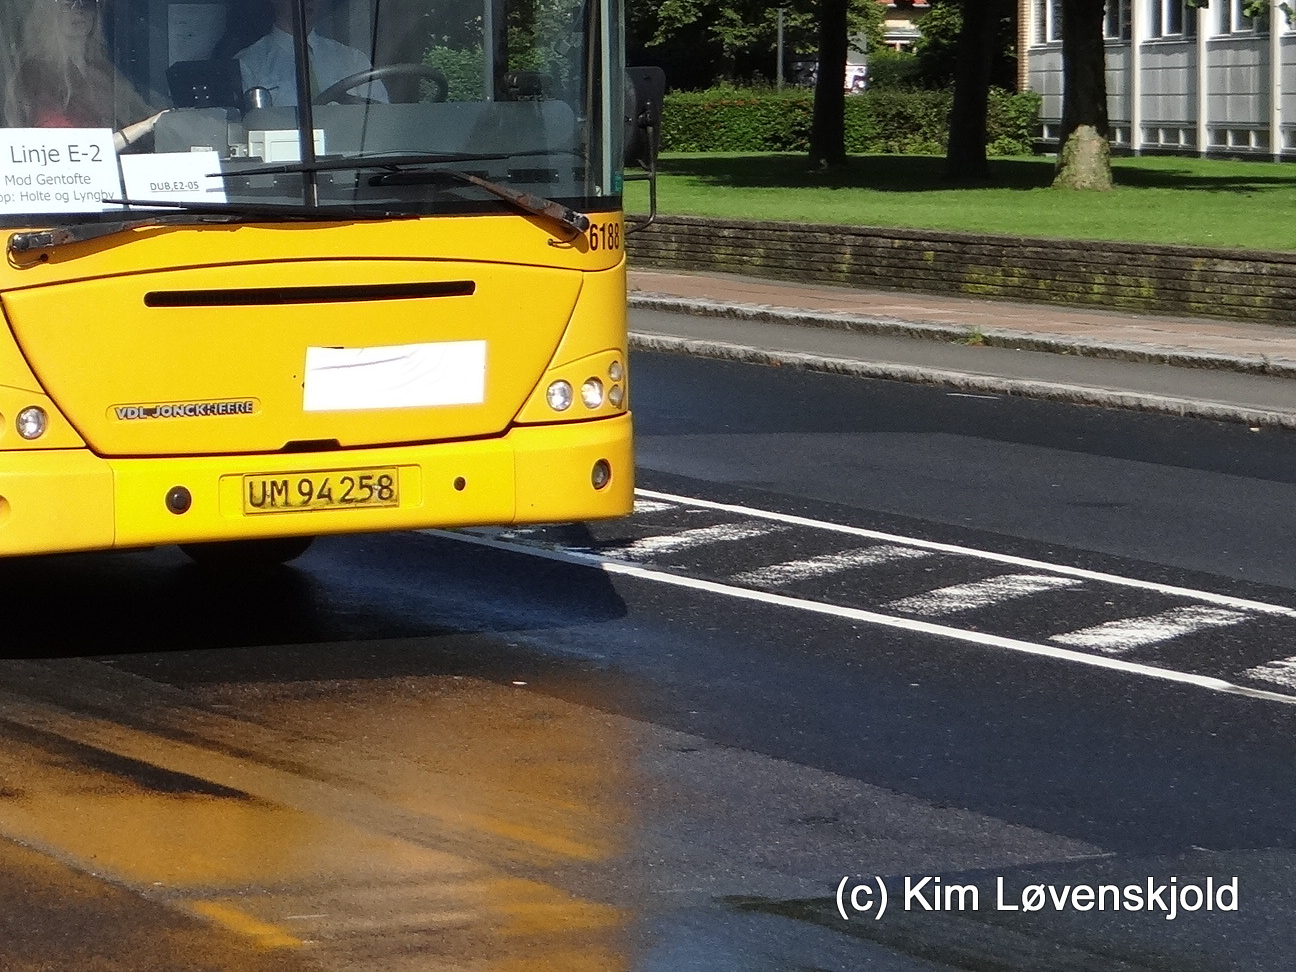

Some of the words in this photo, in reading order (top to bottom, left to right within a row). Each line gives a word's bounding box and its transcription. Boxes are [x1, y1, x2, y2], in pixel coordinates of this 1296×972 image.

[10, 144, 60, 166] Linje
[68, 144, 103, 163] E-2
[4, 174, 32, 186] Mod
[36, 172, 92, 186] Gentofte
[20, 190, 51, 202] Holte
[54, 192, 70, 204] og
[73, 190, 115, 204] Lyngby
[589, 222, 620, 251] 6188
[114, 406, 148, 420] VDL
[153, 401, 253, 418] JONCKHEERE
[248, 479, 290, 508] UM
